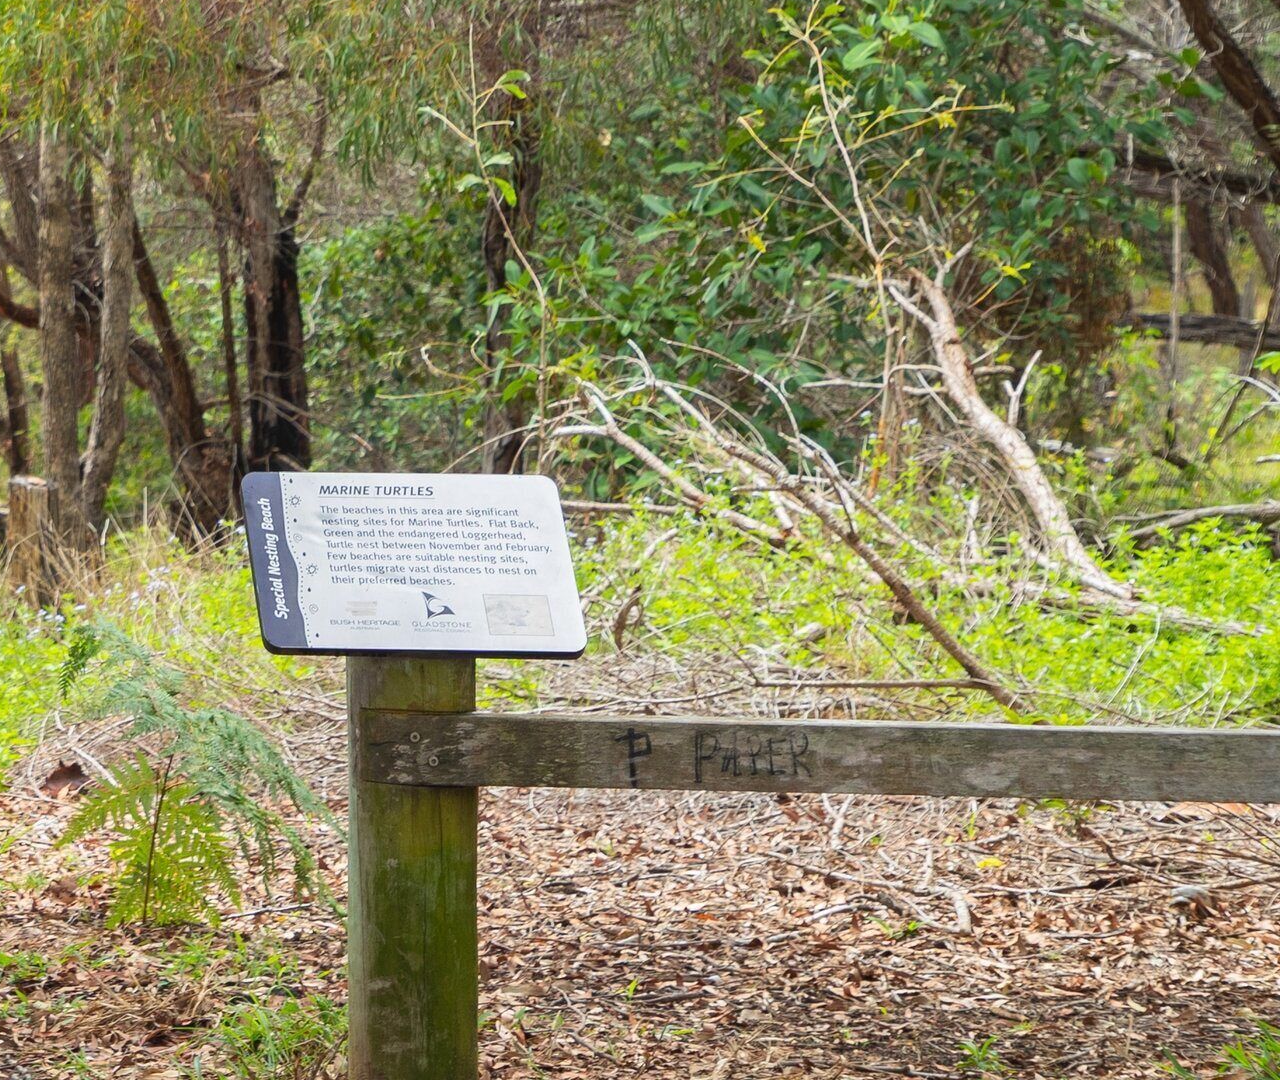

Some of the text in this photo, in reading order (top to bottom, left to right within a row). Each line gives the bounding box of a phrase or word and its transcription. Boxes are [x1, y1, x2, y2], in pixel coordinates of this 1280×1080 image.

[319, 484, 434, 496] MARINE TURTLES
[320, 505, 339, 514] The
[342, 506, 384, 514] beaches
[387, 506, 396, 514] in
[399, 506, 418, 515] this
[465, 507, 519, 518] significant
[321, 517, 539, 530] nesting sites for Marine Turtles. Flat Back,
[323, 528, 353, 537] Green
[356, 529, 375, 537] and
[378, 529, 394, 537] the
[398, 530, 458, 540] endangered
[326, 540, 552, 554] Turtle nest between November and February.
[257, 497, 290, 620] Special Nesting Beach
[327, 552, 347, 560] Few
[350, 552, 392, 561] beaches
[415, 553, 455, 562] suitable
[458, 554, 497, 564] nesting
[329, 564, 363, 573] turtles
[366, 564, 405, 574] migrate
[408, 565, 430, 573] vast
[433, 565, 481, 574] distances
[484, 566, 495, 575] to
[498, 566, 521, 575] nest
[331, 575, 456, 586] their preferred beaches.
